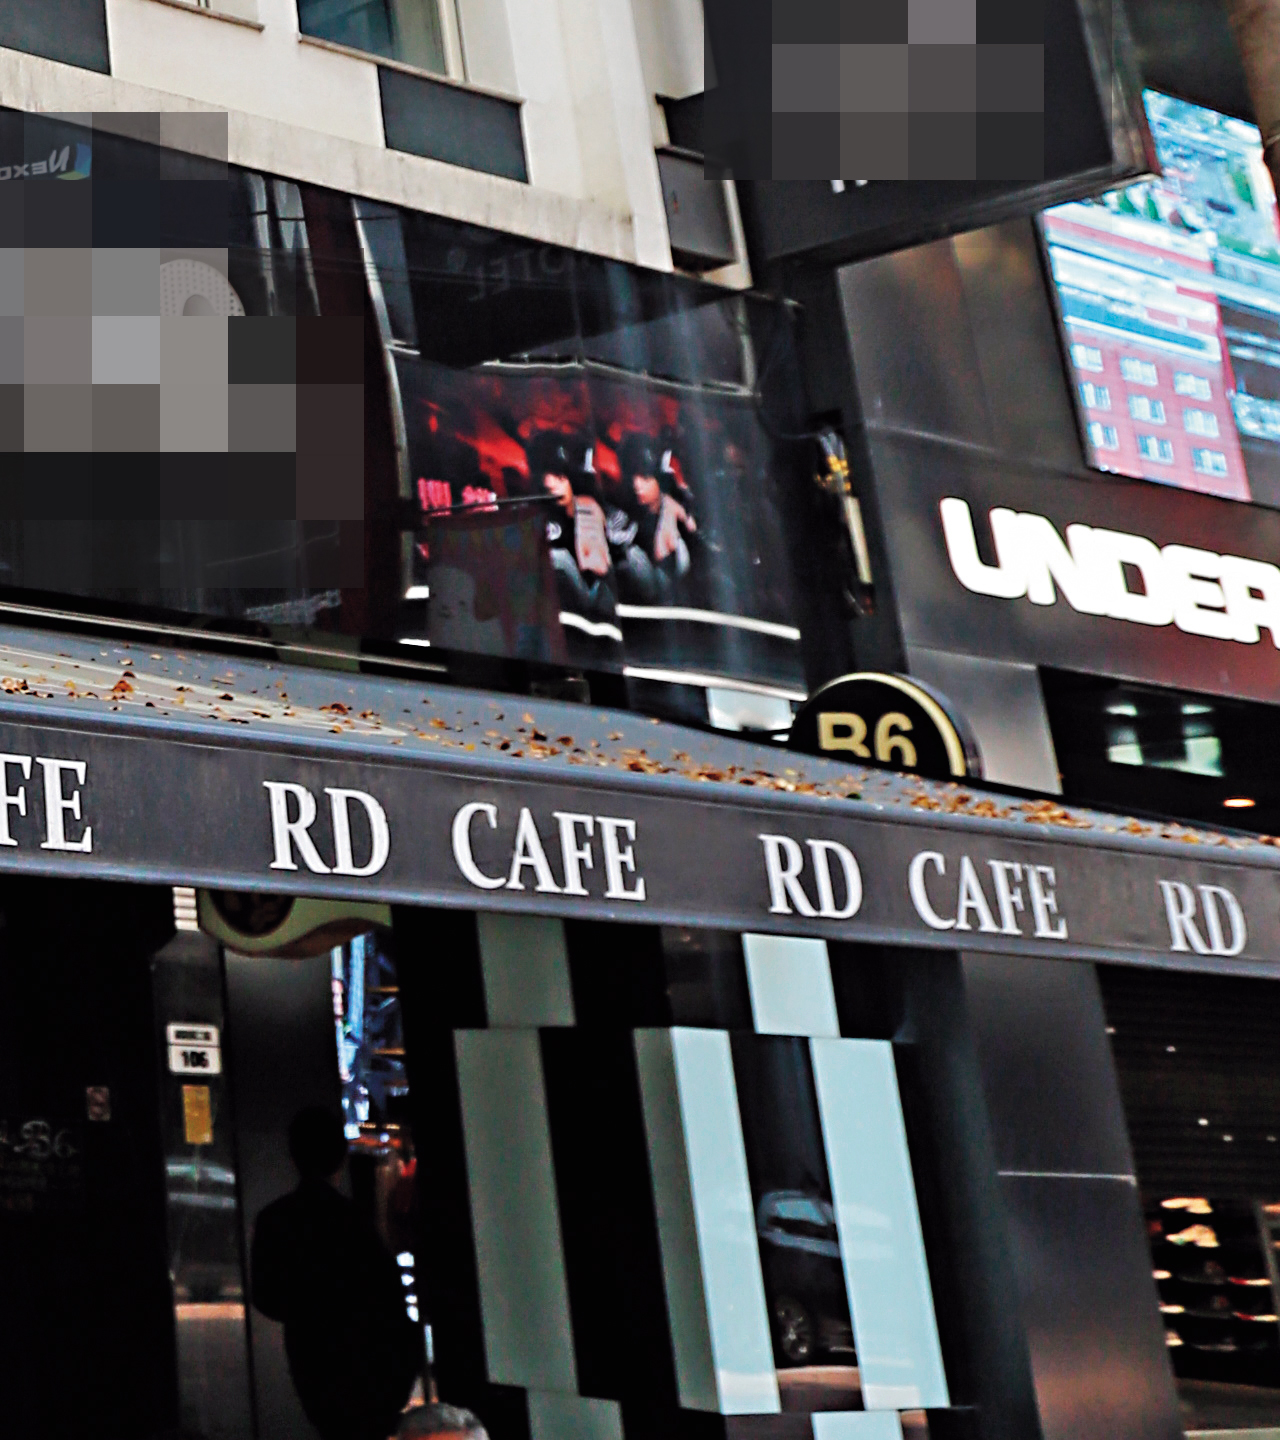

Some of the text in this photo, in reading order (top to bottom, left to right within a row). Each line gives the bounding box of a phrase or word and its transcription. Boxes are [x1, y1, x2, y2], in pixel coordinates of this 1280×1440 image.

[262, 780, 646, 901] RD CAFE
[757, 833, 1068, 940] RD CAFE
[1157, 879, 1247, 957] RD
